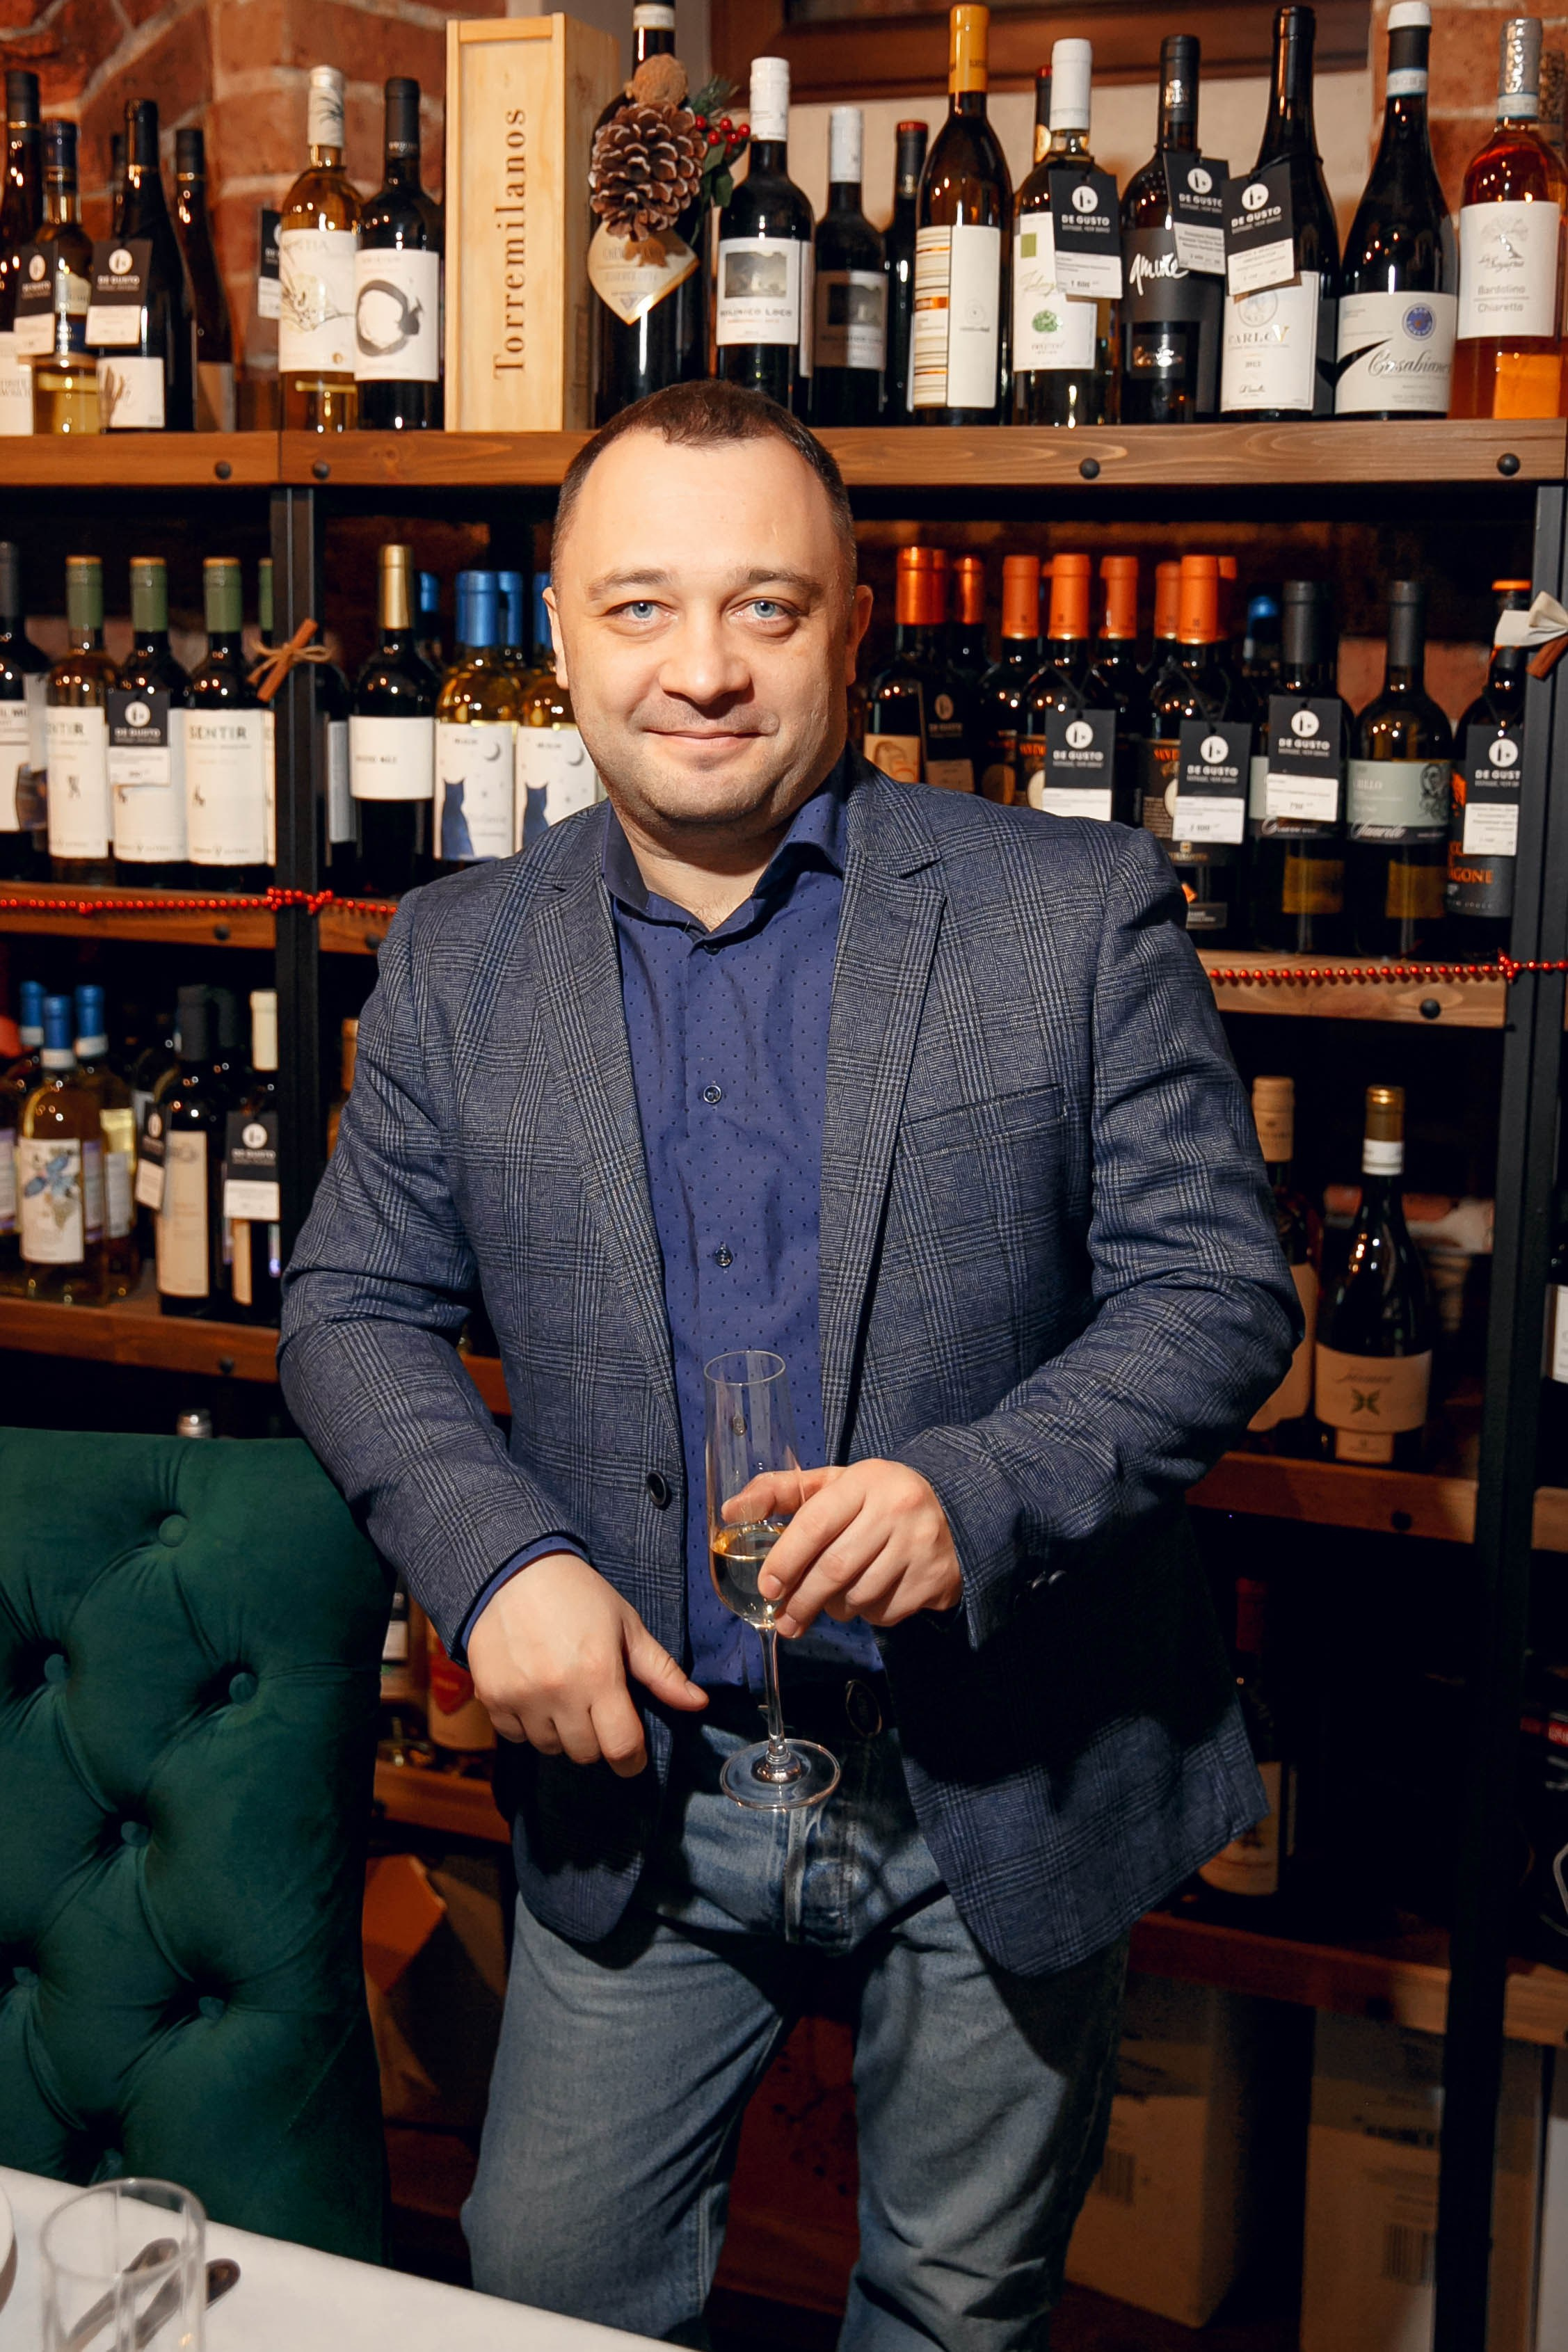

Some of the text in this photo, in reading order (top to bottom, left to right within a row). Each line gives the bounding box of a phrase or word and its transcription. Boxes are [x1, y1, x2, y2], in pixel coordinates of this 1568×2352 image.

[1178, 193, 1192, 202] DE
[1062, 214, 1110, 226] DE GUSTO
[1231, 217, 1245, 228] DE
[1246, 206, 1281, 223] GUSTO
[494, 109, 526, 381] Torremilanos
[1478, 285, 1526, 296] Bardolino
[1478, 303, 1524, 313] Chiaretto
[189, 726, 247, 739] SENTIR
[1279, 737, 1330, 751] DE GUSTO
[1053, 750, 1103, 761] DE GUSTO
[1187, 765, 1239, 776] DE GUSTO
[1475, 769, 1521, 781] DE GUST
